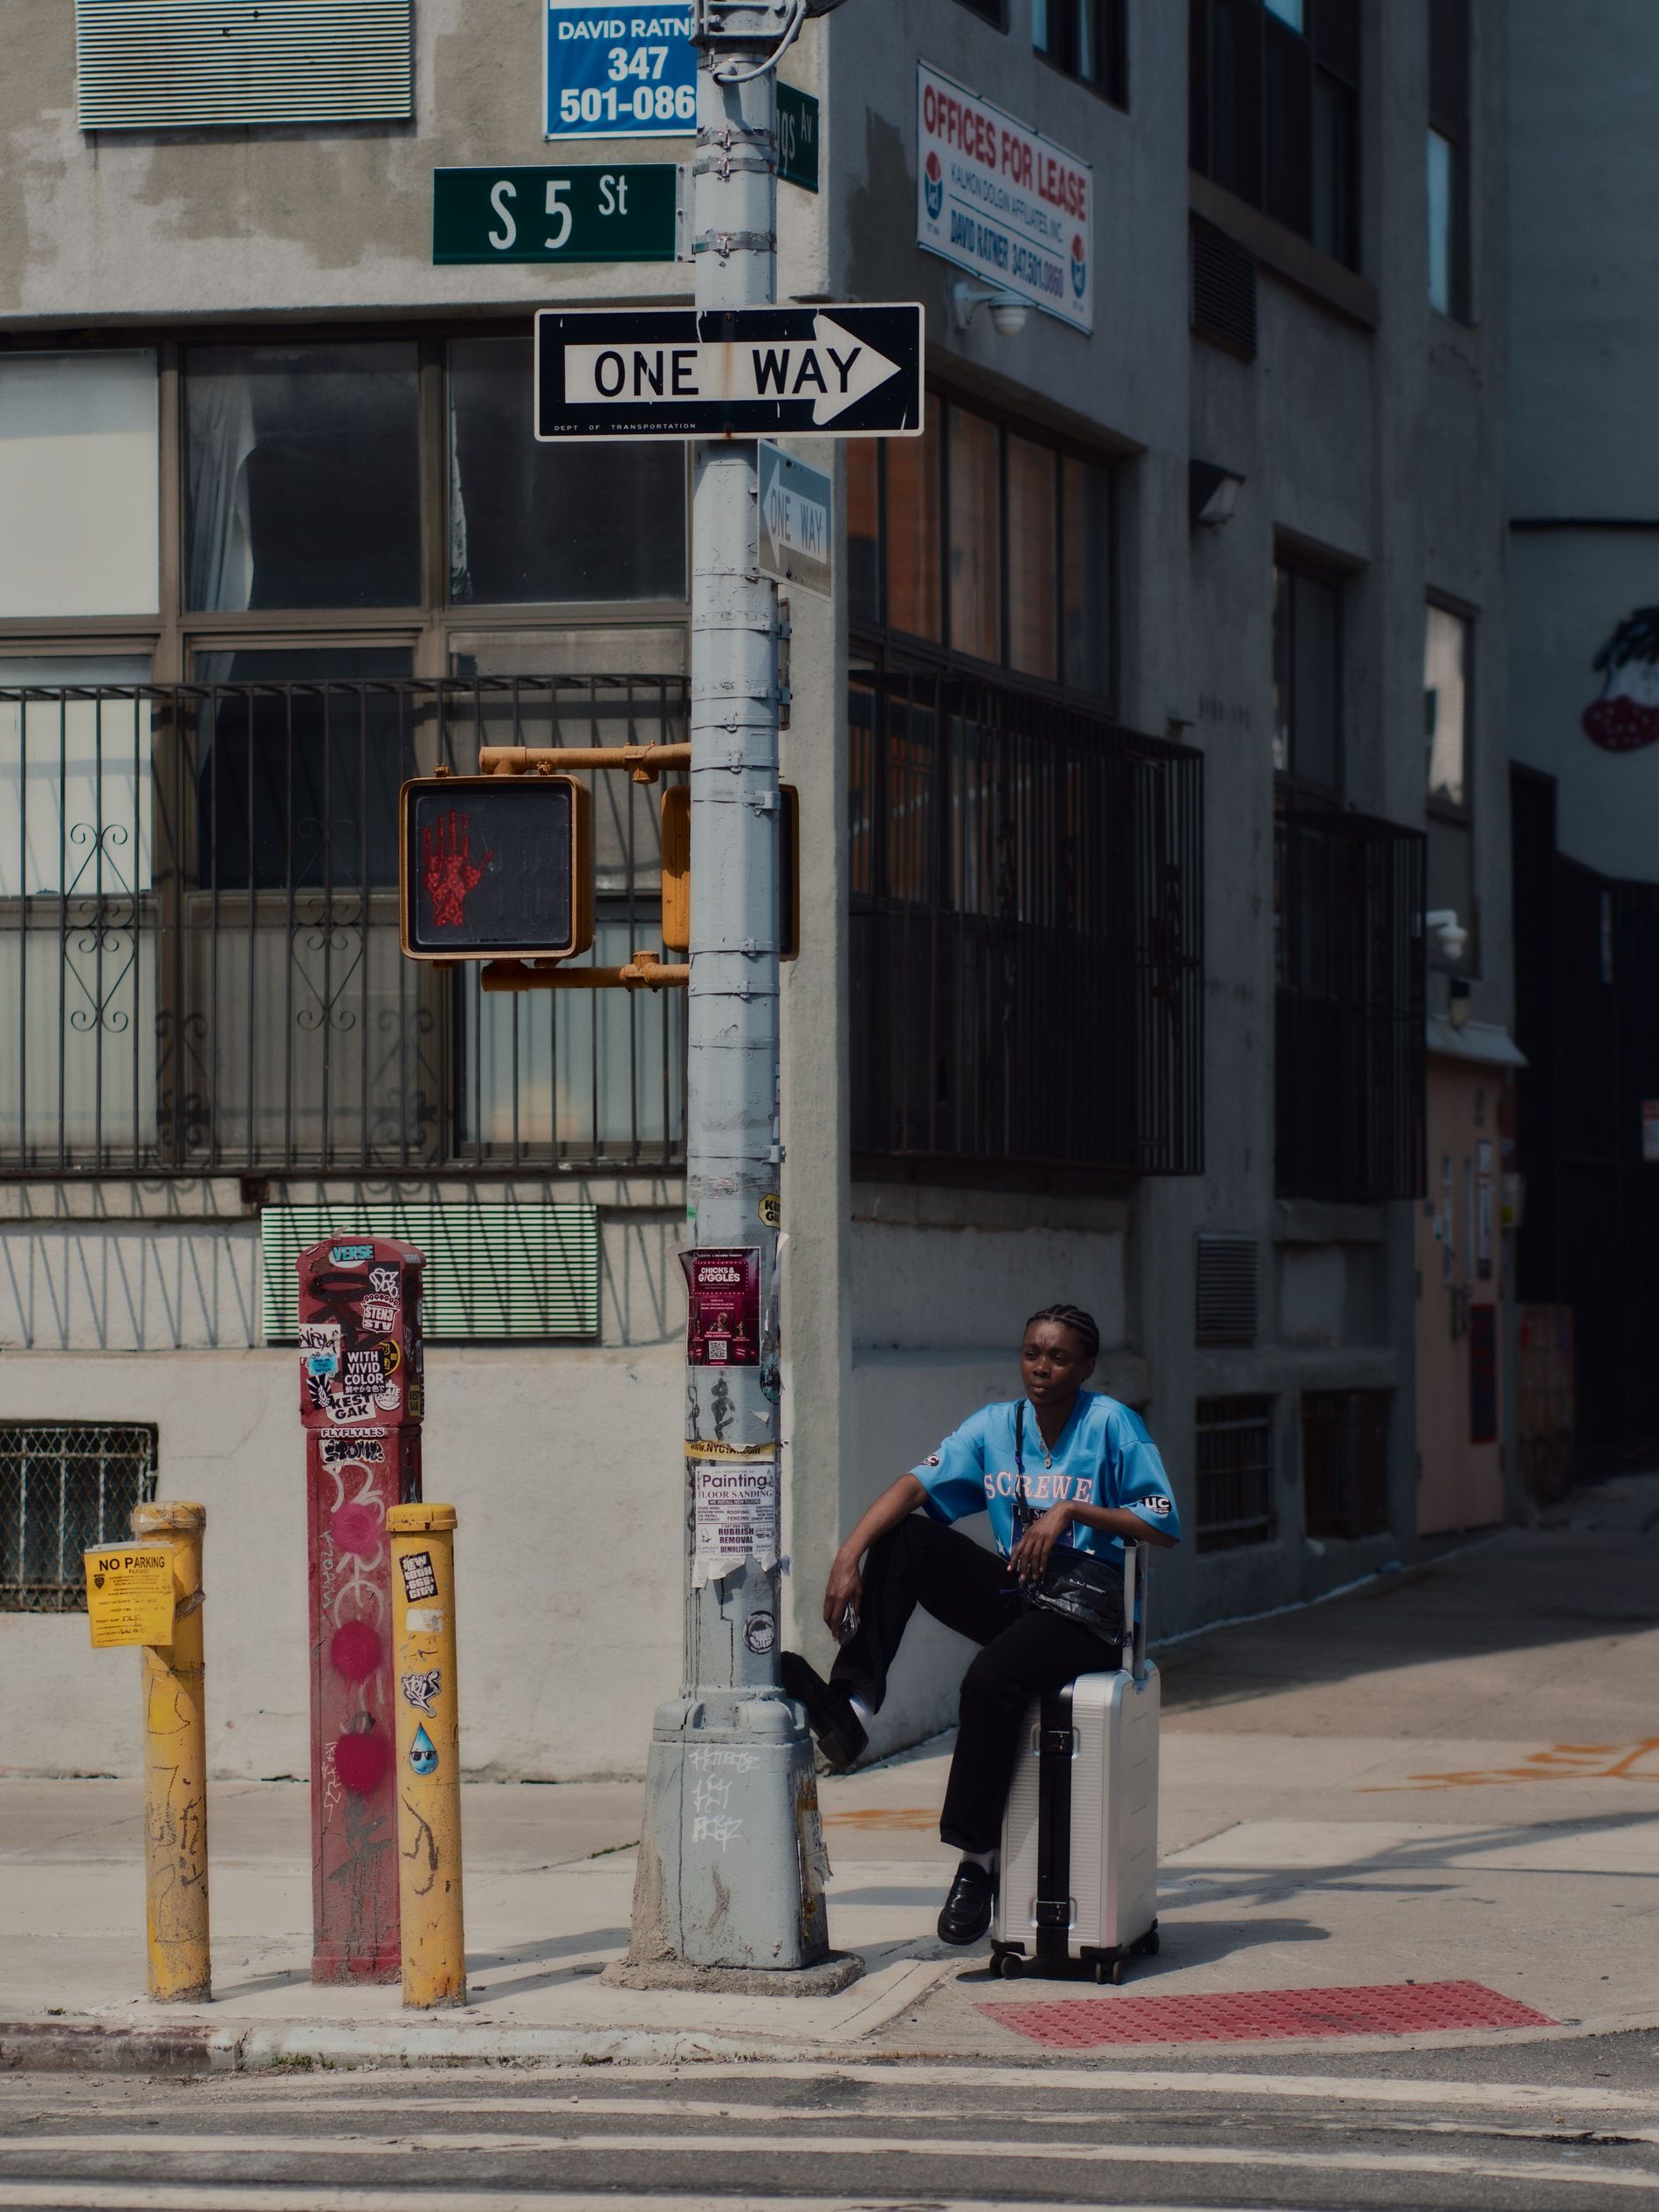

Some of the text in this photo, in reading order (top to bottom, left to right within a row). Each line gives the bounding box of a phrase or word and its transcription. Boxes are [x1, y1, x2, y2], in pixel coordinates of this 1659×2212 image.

[559, 17, 694, 40] DAVID RATN
[608, 46, 669, 81] 347
[801, 101, 812, 143] Av
[924, 85, 1086, 222] OFFICES FOR LEASE
[952, 162, 981, 197] KALMON
[488, 175, 628, 250] S 5 St
[951, 210, 974, 252] DAVID
[978, 224, 1008, 270] RATNER
[594, 347, 863, 397] ONE WAY
[770, 488, 823, 555] ONE WAY
[332, 1244, 375, 1261] VERSE
[698, 1273, 740, 1282] GIGGLES
[363, 1320, 392, 1332] STV
[348, 1351, 379, 1362] WITH
[348, 1362, 380, 1374] VIVID
[344, 1374, 384, 1385] COLOR
[332, 1395, 371, 1409] KEST
[335, 1404, 368, 1419] GAK
[322, 1428, 384, 1437] FLYFLYLES
[702, 1473, 767, 1489] Painting
[1140, 1497, 1170, 1508] UC
[99, 1556, 165, 1571] NO PARKING
